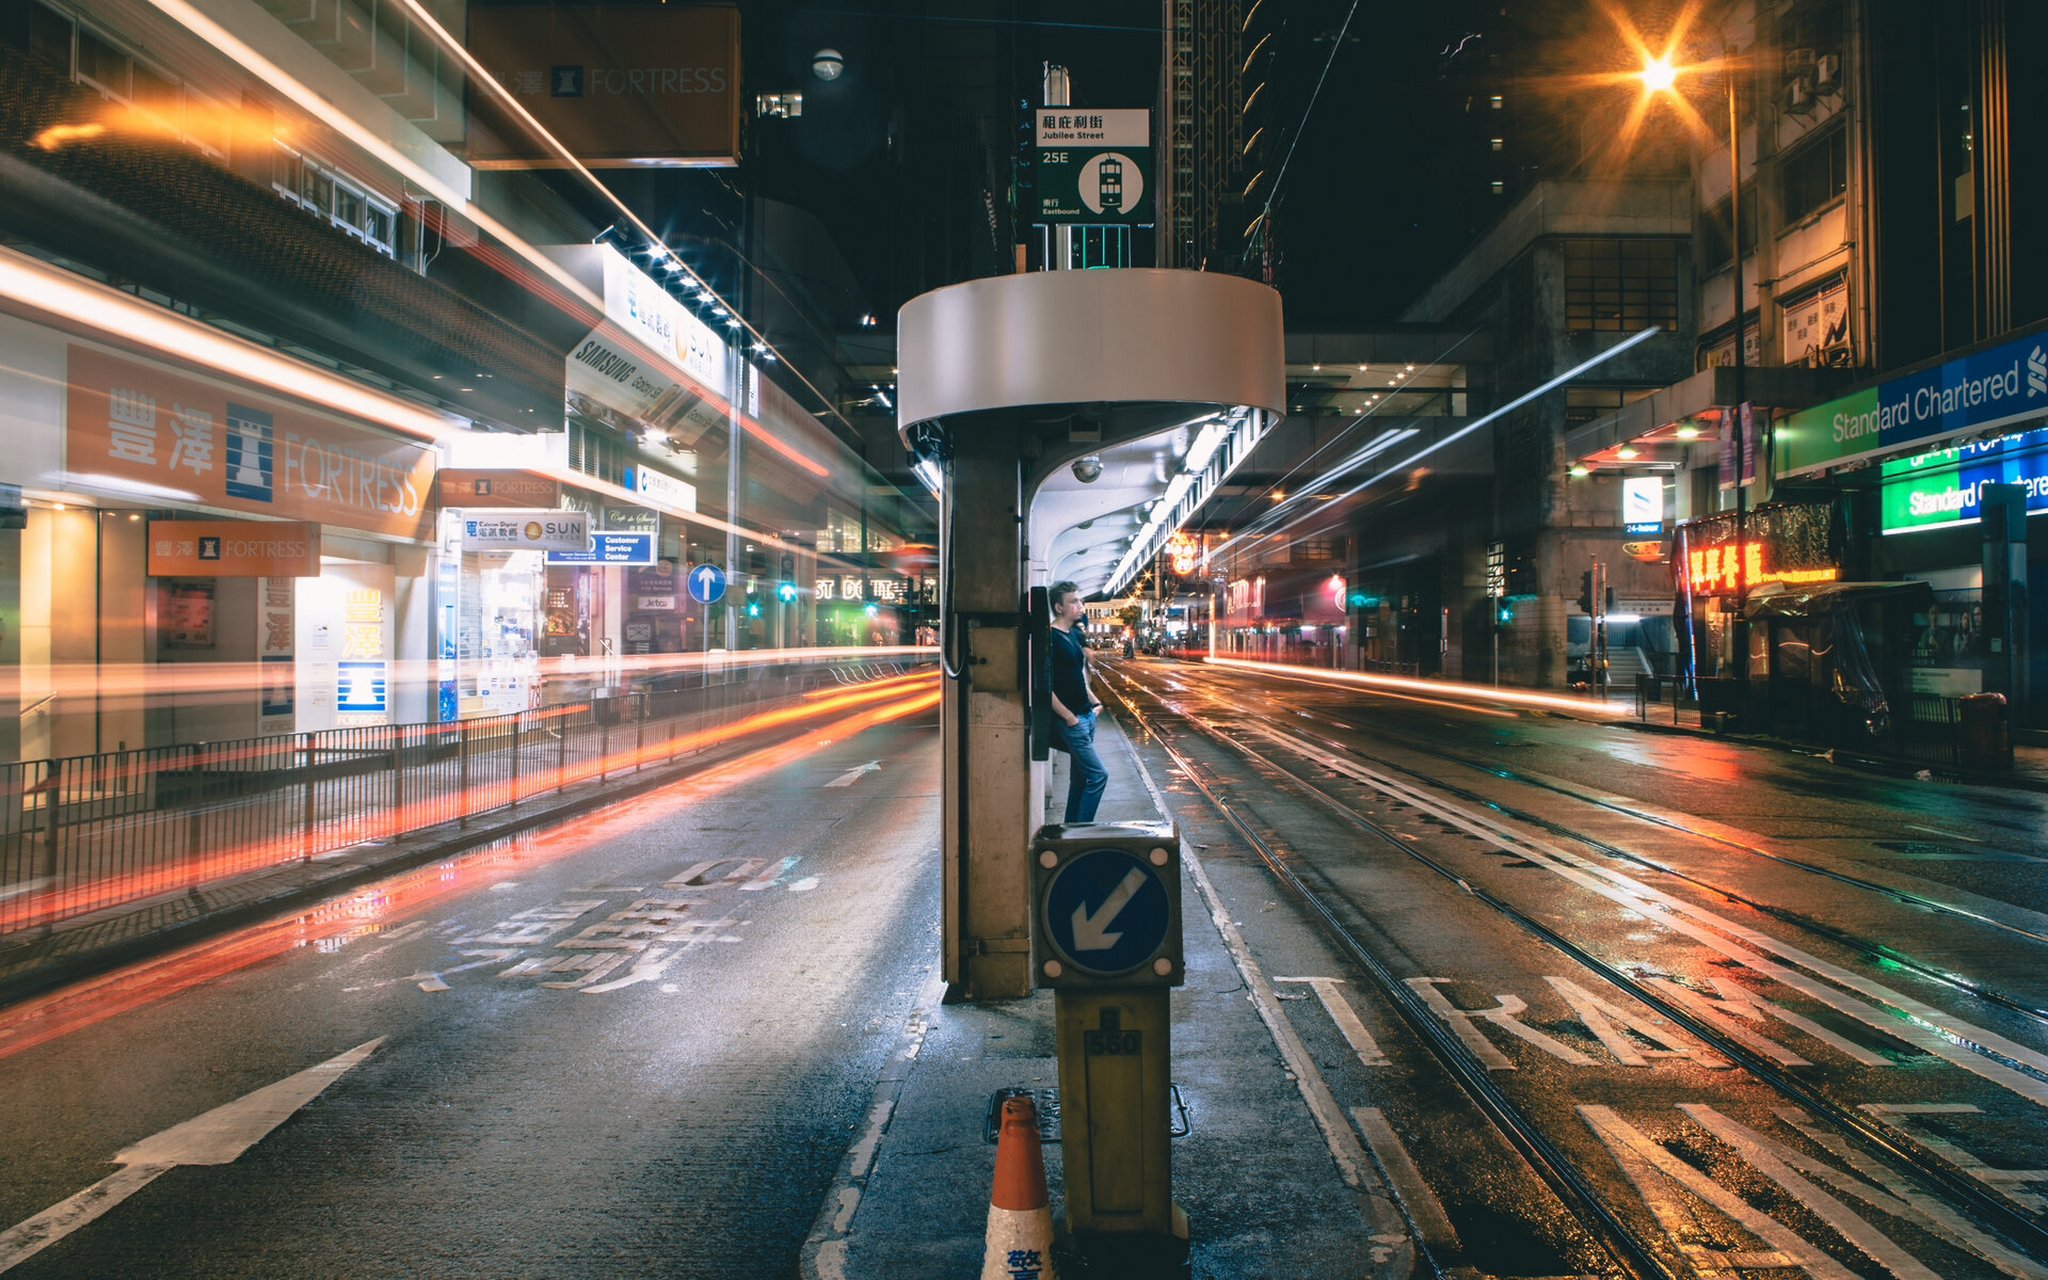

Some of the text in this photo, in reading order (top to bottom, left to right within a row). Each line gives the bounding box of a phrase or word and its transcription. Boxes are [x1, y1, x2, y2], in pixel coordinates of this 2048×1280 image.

[590, 67, 726, 95] FORTRESS
[1042, 115, 1103, 129] 租庇利街
[1042, 131, 1104, 139] Jubilee Street
[1043, 152, 1069, 163] 25E
[1043, 199, 1059, 207] 東行
[575, 341, 636, 383] SAMSUNG
[1832, 360, 2019, 443] Standard Chartered
[107, 387, 213, 476] 豐澤
[284, 431, 418, 517] FORTRESS
[493, 480, 552, 496] FORTRESS
[1909, 482, 1976, 516] Standard
[545, 522, 581, 534] SUN
[154, 540, 193, 556] 豐澤
[225, 540, 305, 559] FORTRESS
[605, 536, 640, 544] Customer
[1274, 975, 1897, 1071] TRAM
[1088, 1033, 1139, 1055] 560
